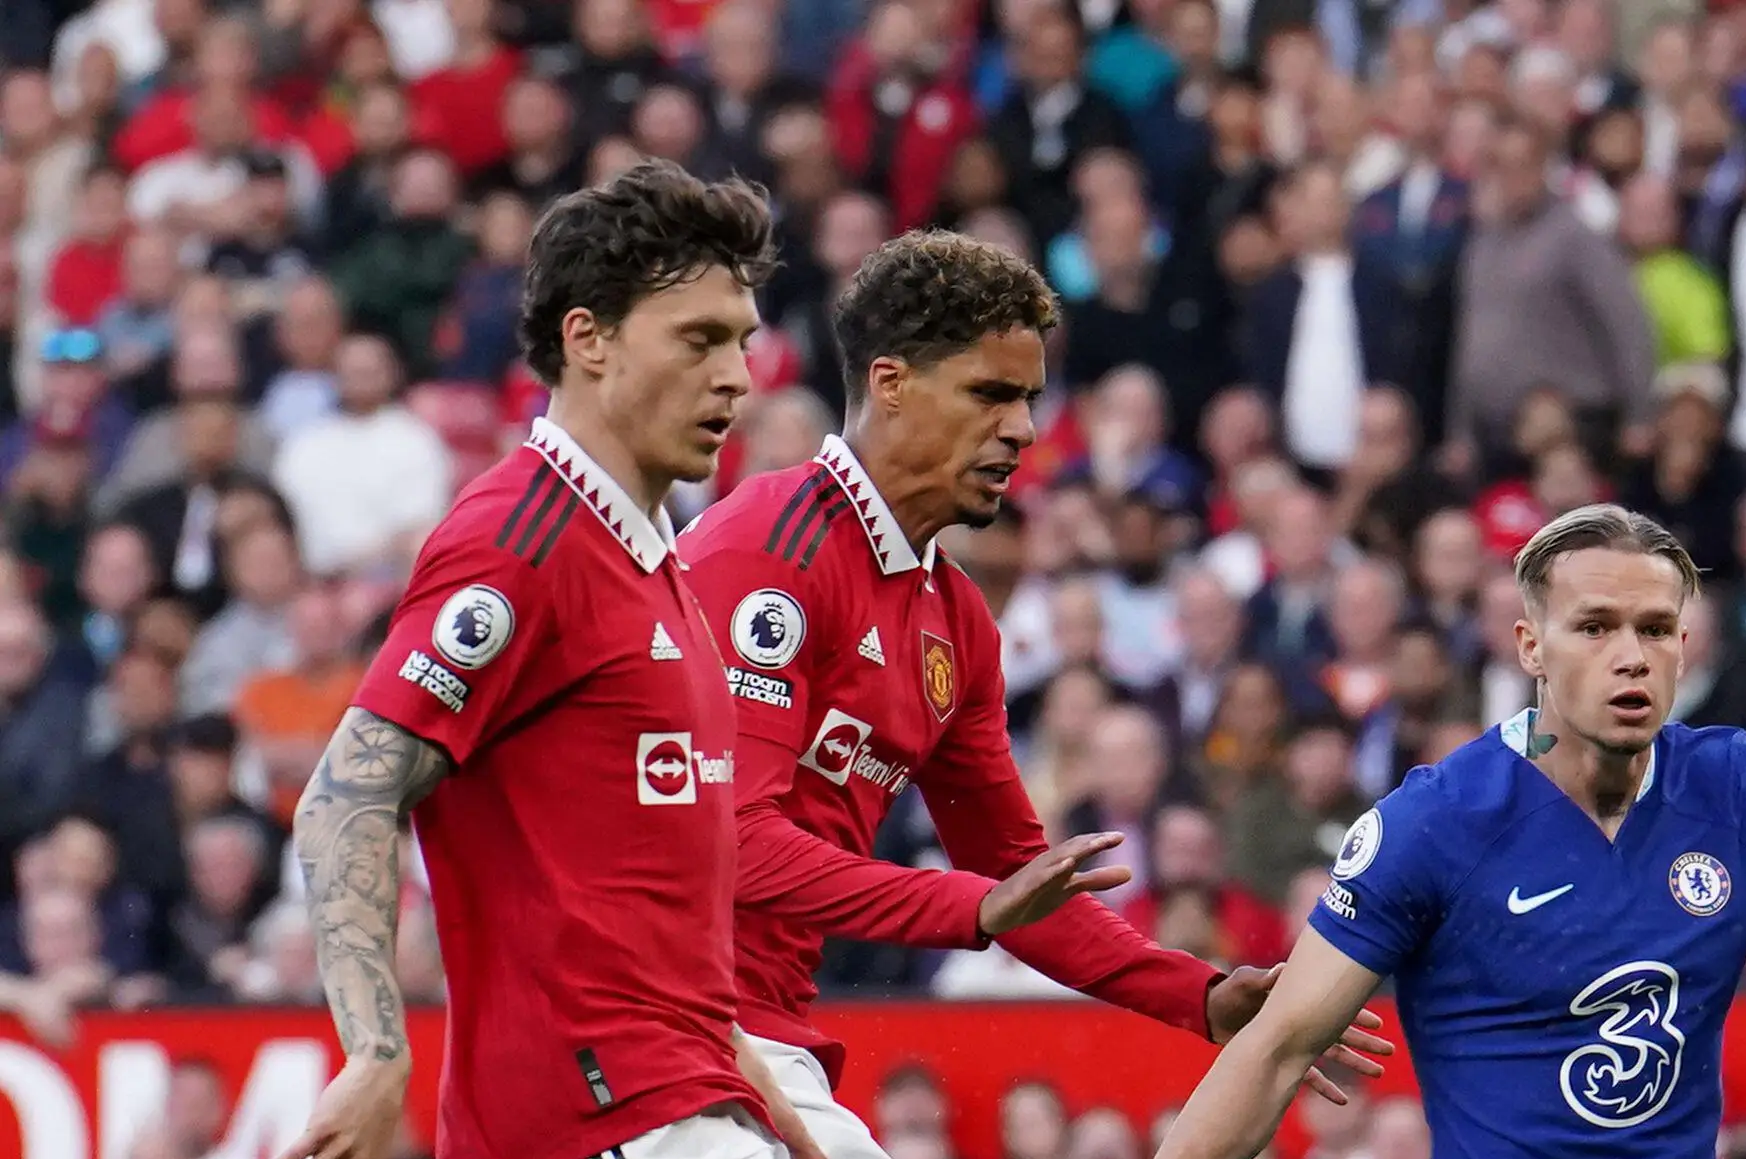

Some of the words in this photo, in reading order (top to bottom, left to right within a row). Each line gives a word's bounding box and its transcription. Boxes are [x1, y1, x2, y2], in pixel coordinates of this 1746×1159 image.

[420, 676, 465, 714] racism
[428, 665, 468, 699] room
[739, 684, 793, 710] racism
[743, 673, 788, 696] room
